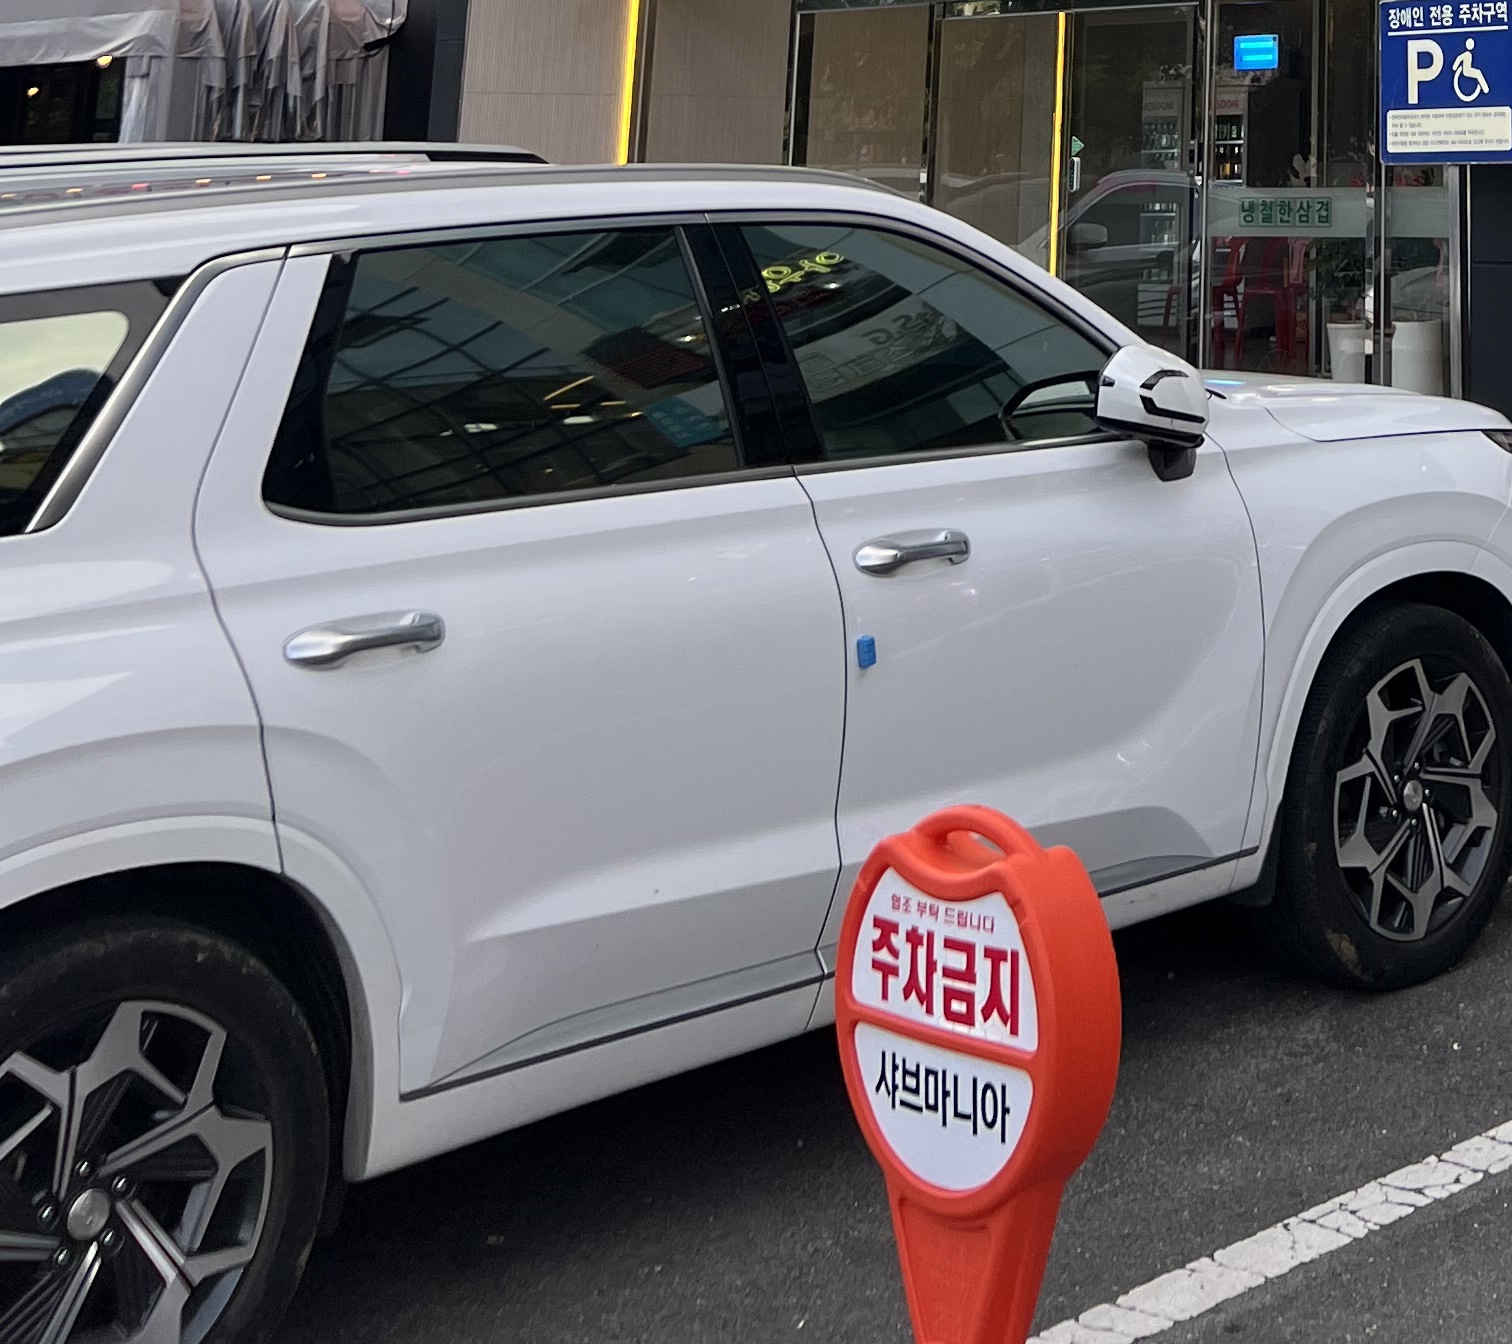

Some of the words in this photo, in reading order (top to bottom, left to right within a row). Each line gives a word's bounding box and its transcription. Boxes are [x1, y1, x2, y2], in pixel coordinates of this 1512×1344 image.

[1388, 6, 1425, 29] 장애인
[1429, 4, 1454, 26] 전용
[1458, 1, 1508, 25] 주차구역
[1407, 39, 1444, 104] P
[917, 900, 940, 922] 부탁
[871, 915, 1020, 1037] 주차금지
[875, 1050, 1011, 1144] 샤브마니아
